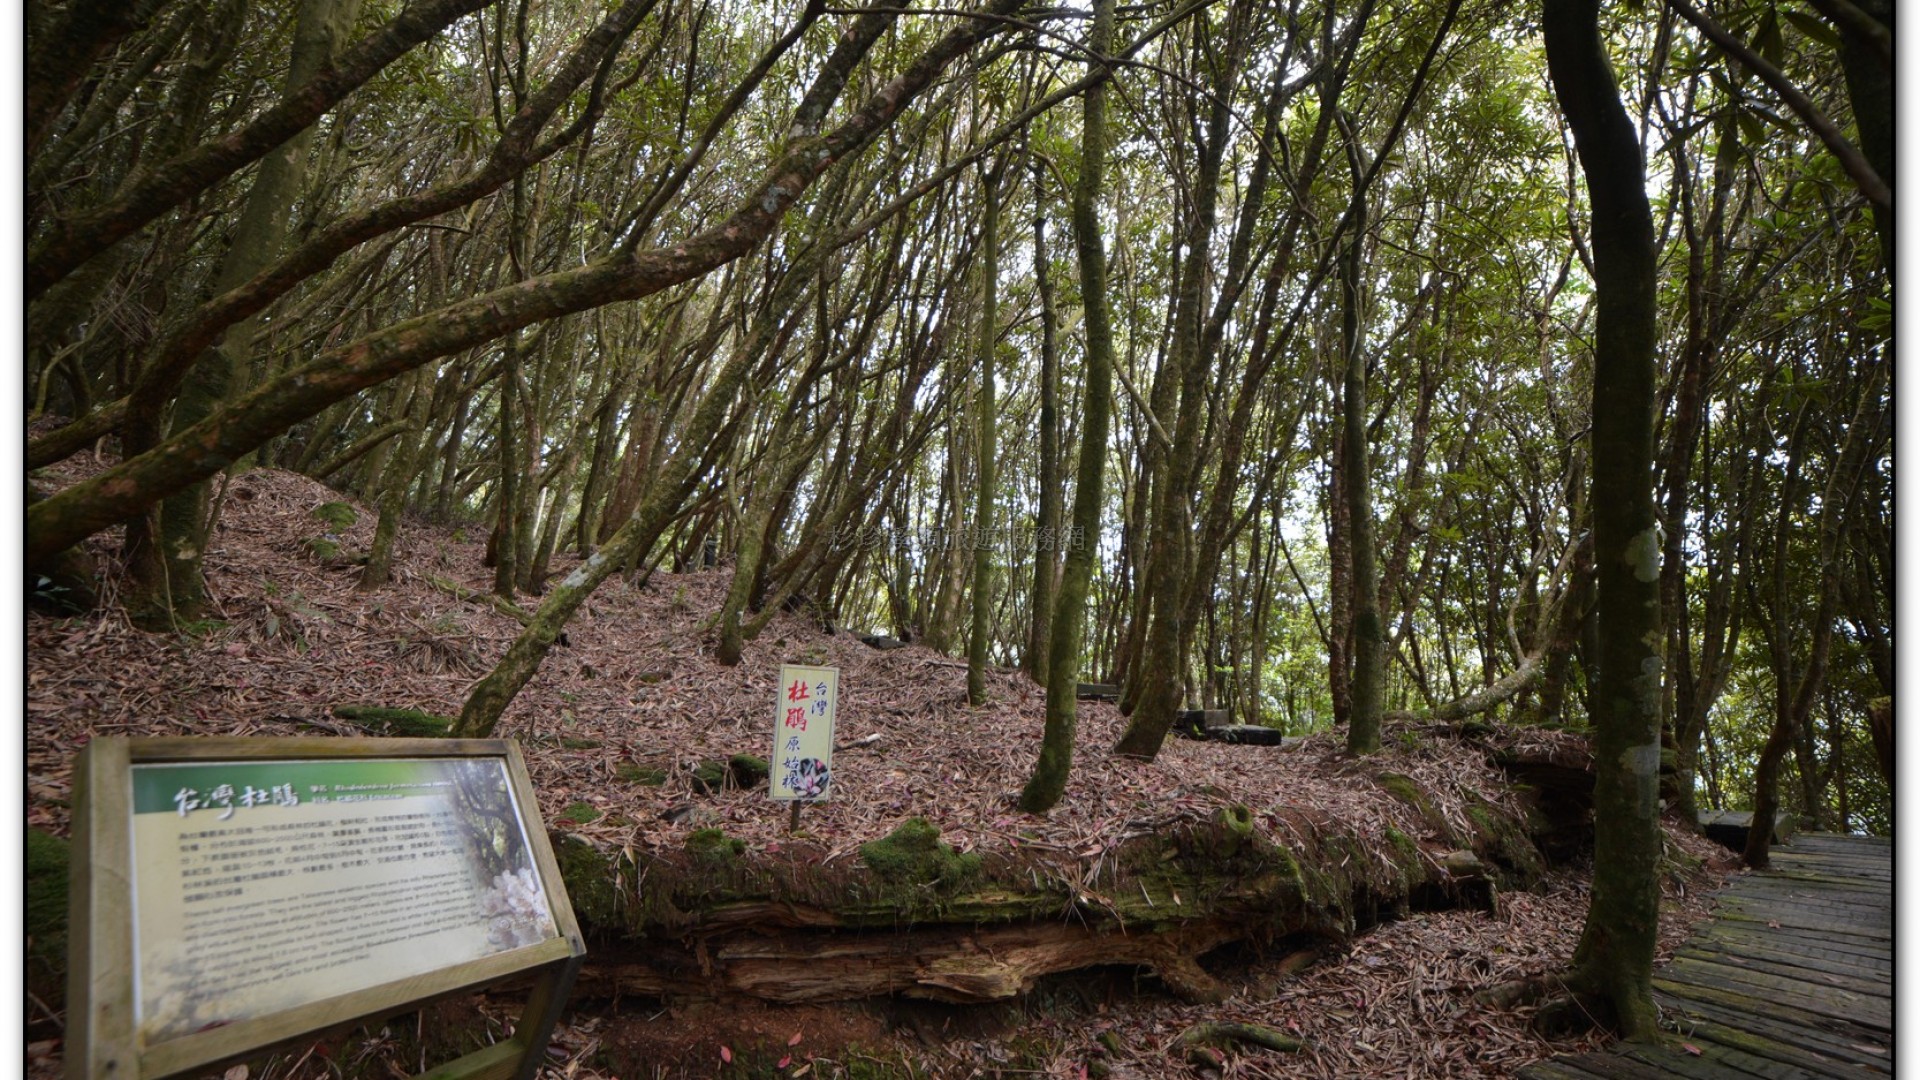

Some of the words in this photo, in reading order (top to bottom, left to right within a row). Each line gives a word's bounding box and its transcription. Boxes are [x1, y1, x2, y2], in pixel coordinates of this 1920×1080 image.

[811, 681, 828, 717] 台灣
[173, 783, 299, 820] 台灣杜鵑
